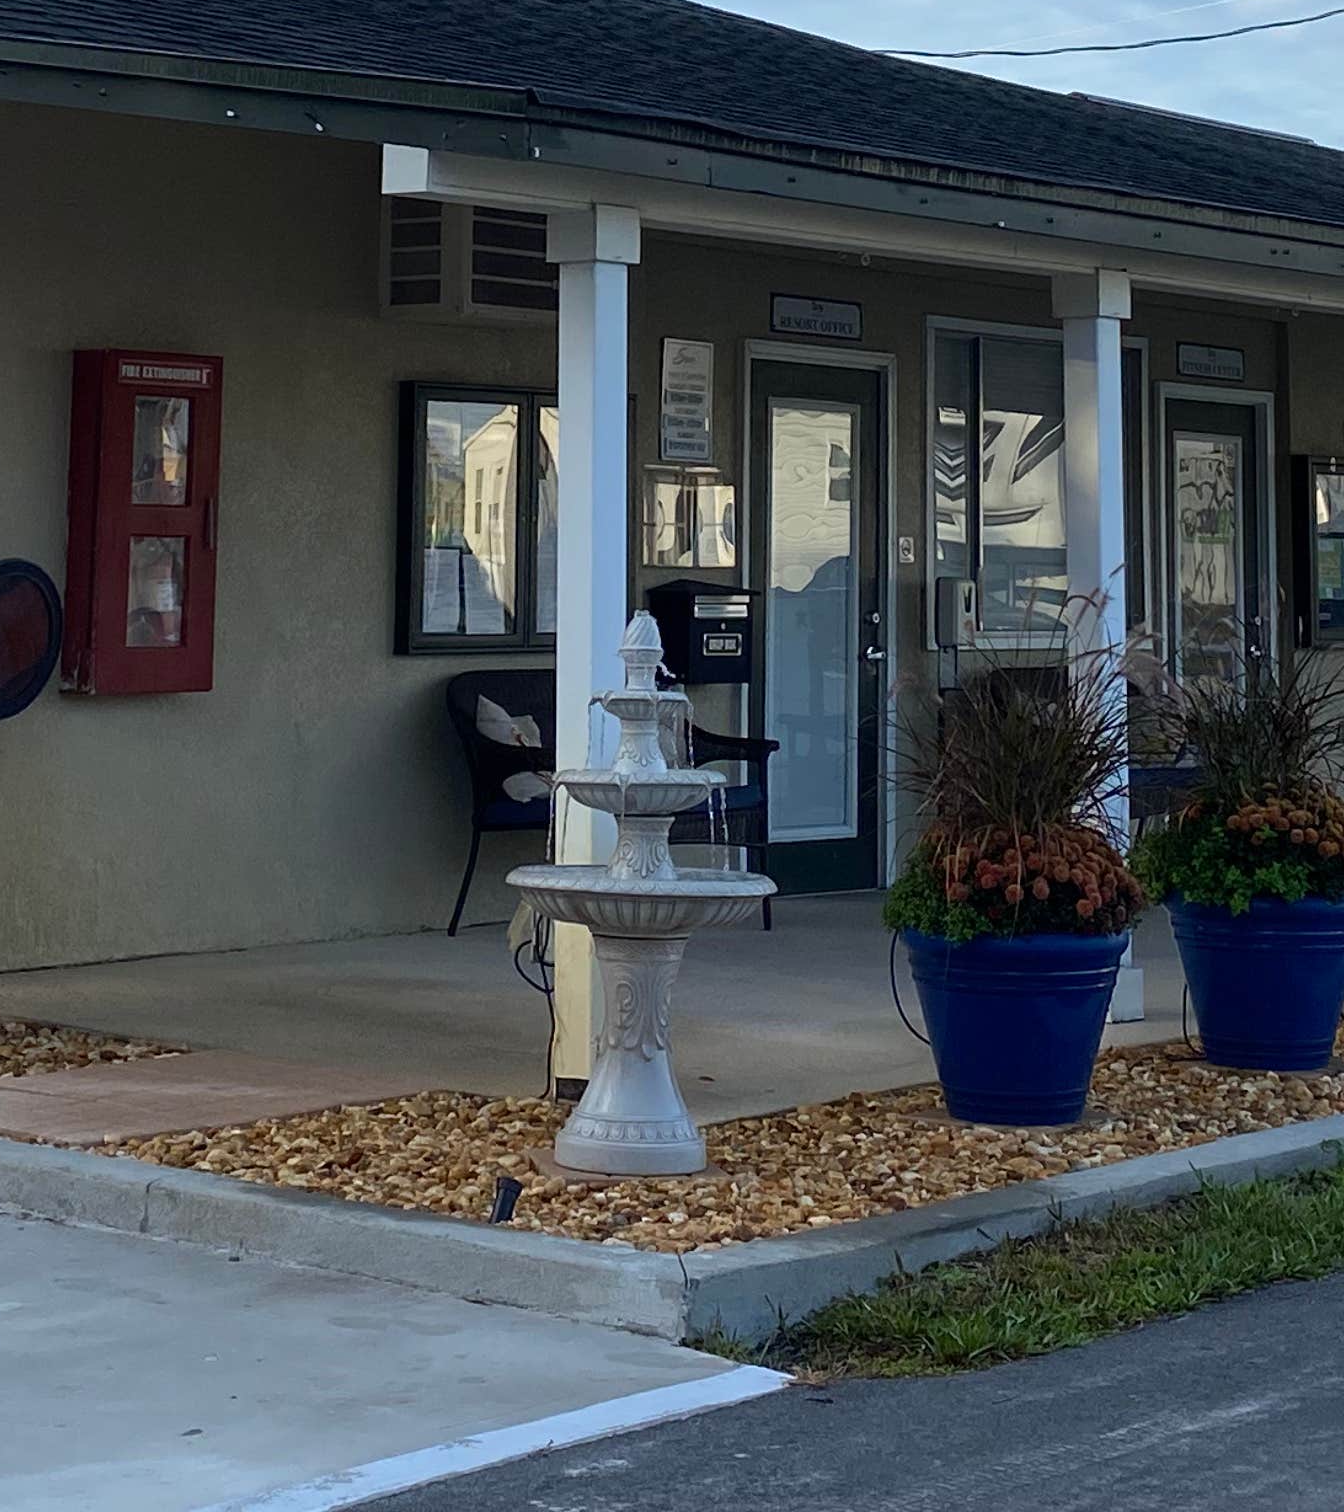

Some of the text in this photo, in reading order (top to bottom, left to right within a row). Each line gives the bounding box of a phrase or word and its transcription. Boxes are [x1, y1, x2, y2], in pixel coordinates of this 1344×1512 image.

[780, 315, 854, 335] RESORT OFFICE
[121, 364, 202, 382] FIRE EXTINGUISHER
